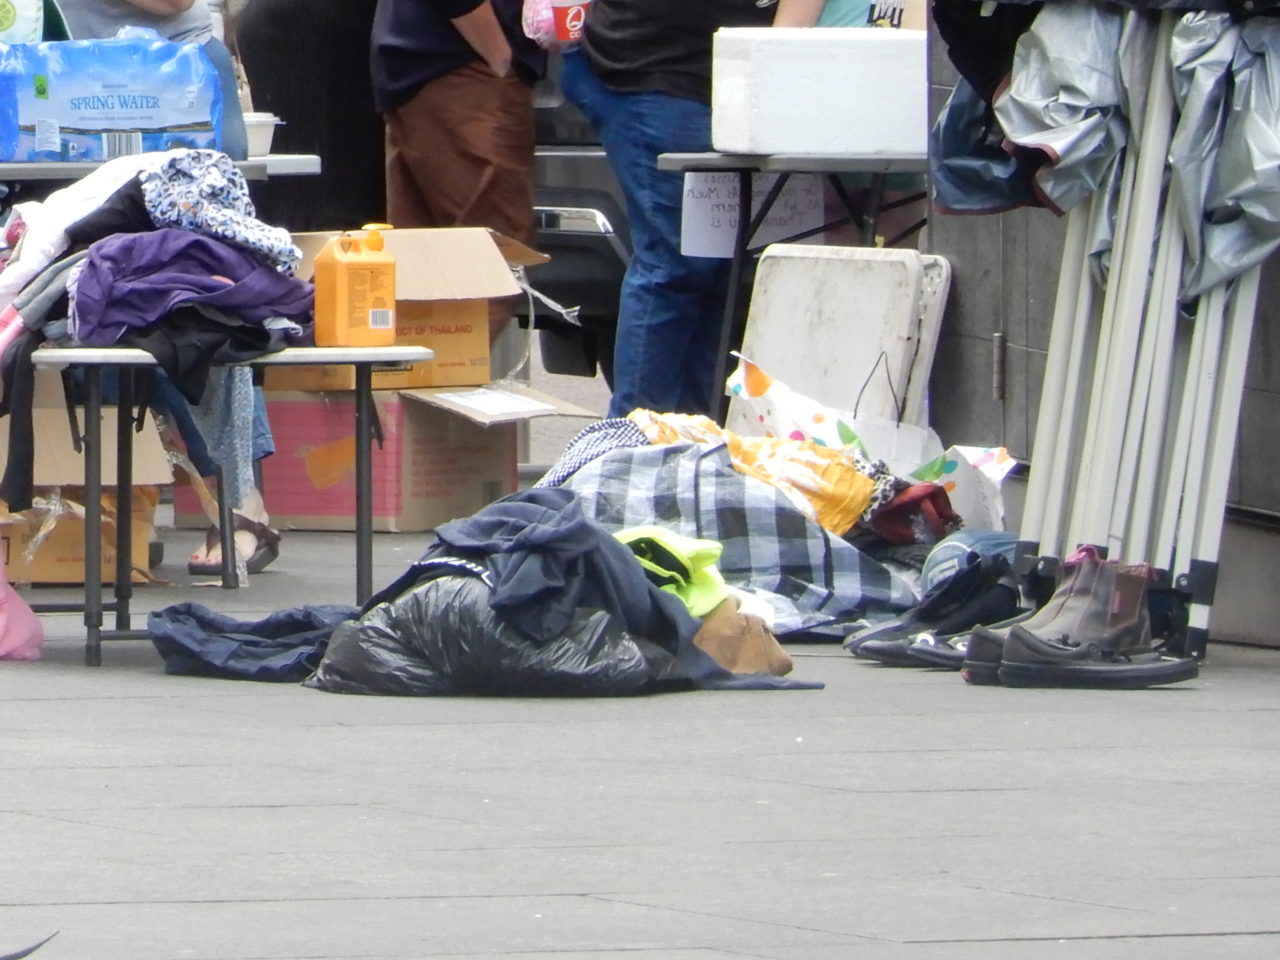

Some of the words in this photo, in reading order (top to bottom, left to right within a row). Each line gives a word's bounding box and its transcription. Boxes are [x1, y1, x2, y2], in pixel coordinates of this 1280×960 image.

[70, 94, 115, 110] SPRING
[117, 94, 161, 110] WATER
[415, 325, 426, 336] OF
[429, 324, 473, 337] THAILAND
